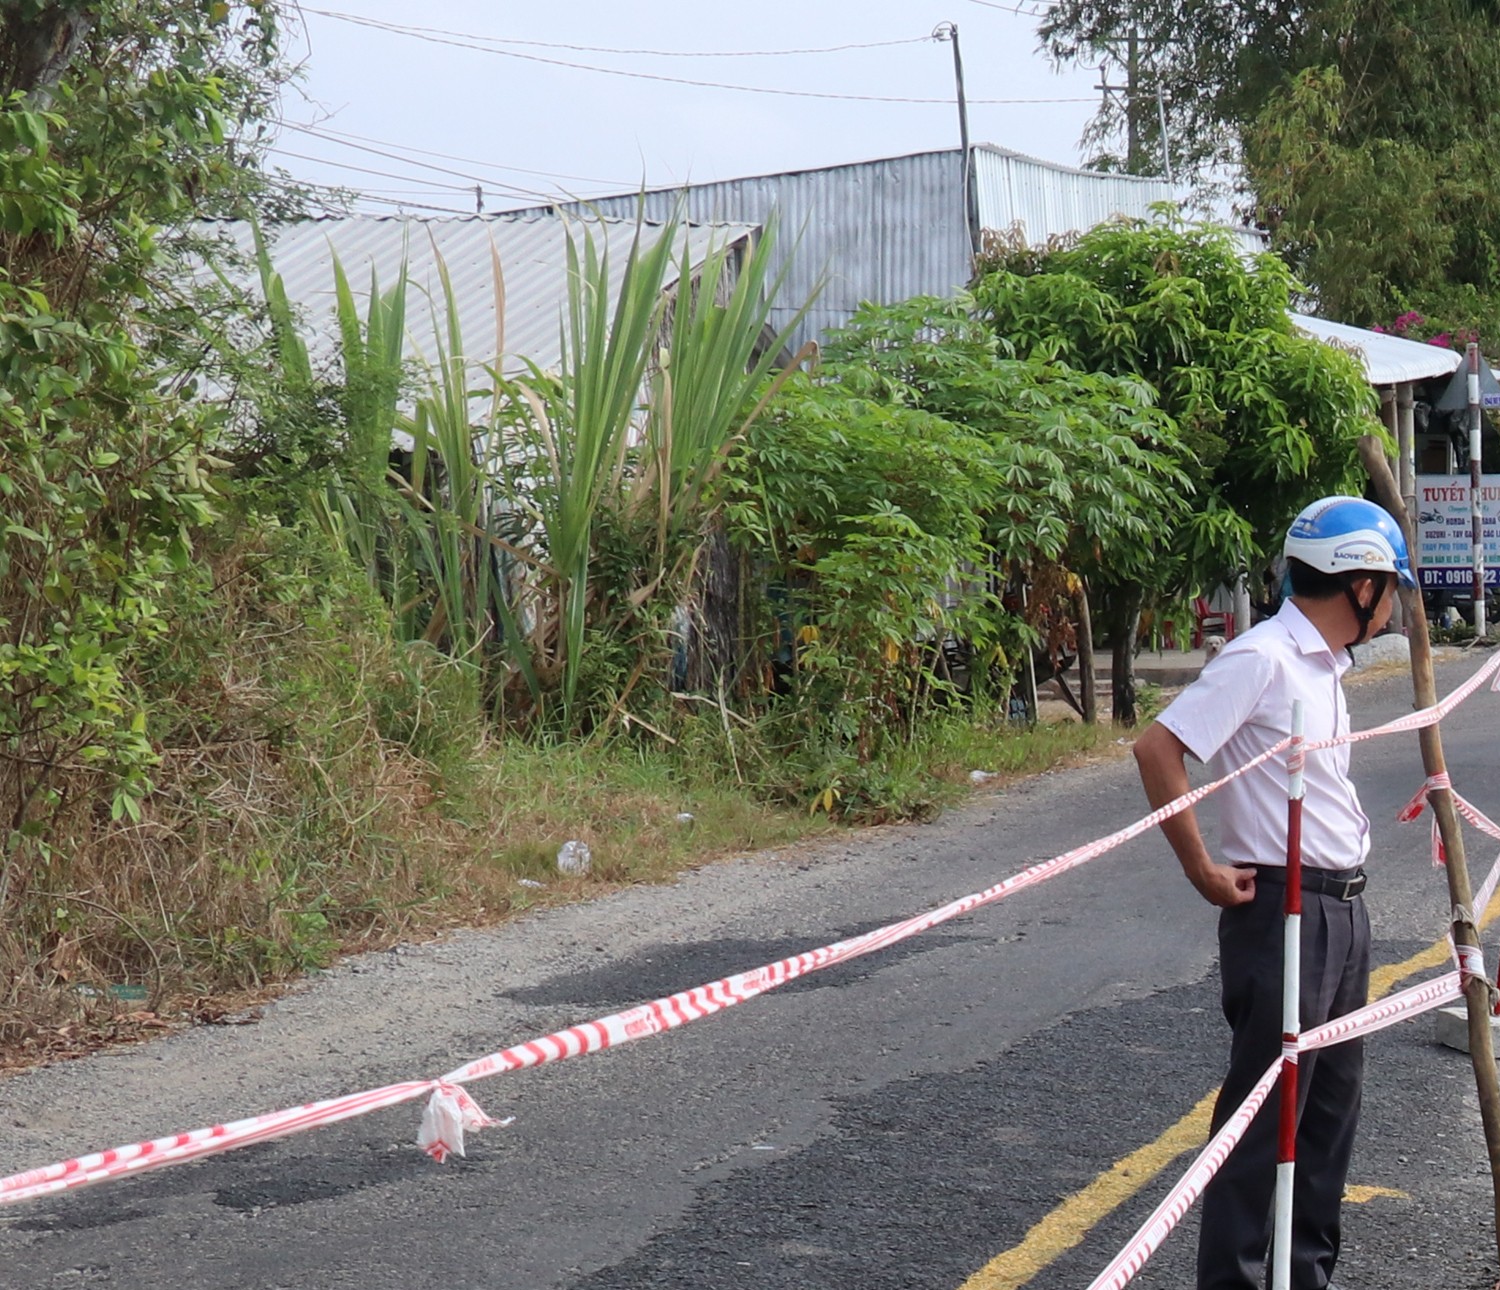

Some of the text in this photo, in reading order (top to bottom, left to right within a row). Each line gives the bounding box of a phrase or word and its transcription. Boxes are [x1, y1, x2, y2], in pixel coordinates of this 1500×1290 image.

[1423, 481, 1465, 501] TUYẾT
[1445, 517, 1465, 525] HONDA
[1425, 530, 1446, 539] SUZUKI
[1453, 530, 1463, 538] TAY
[1446, 570, 1473, 583] 0916
